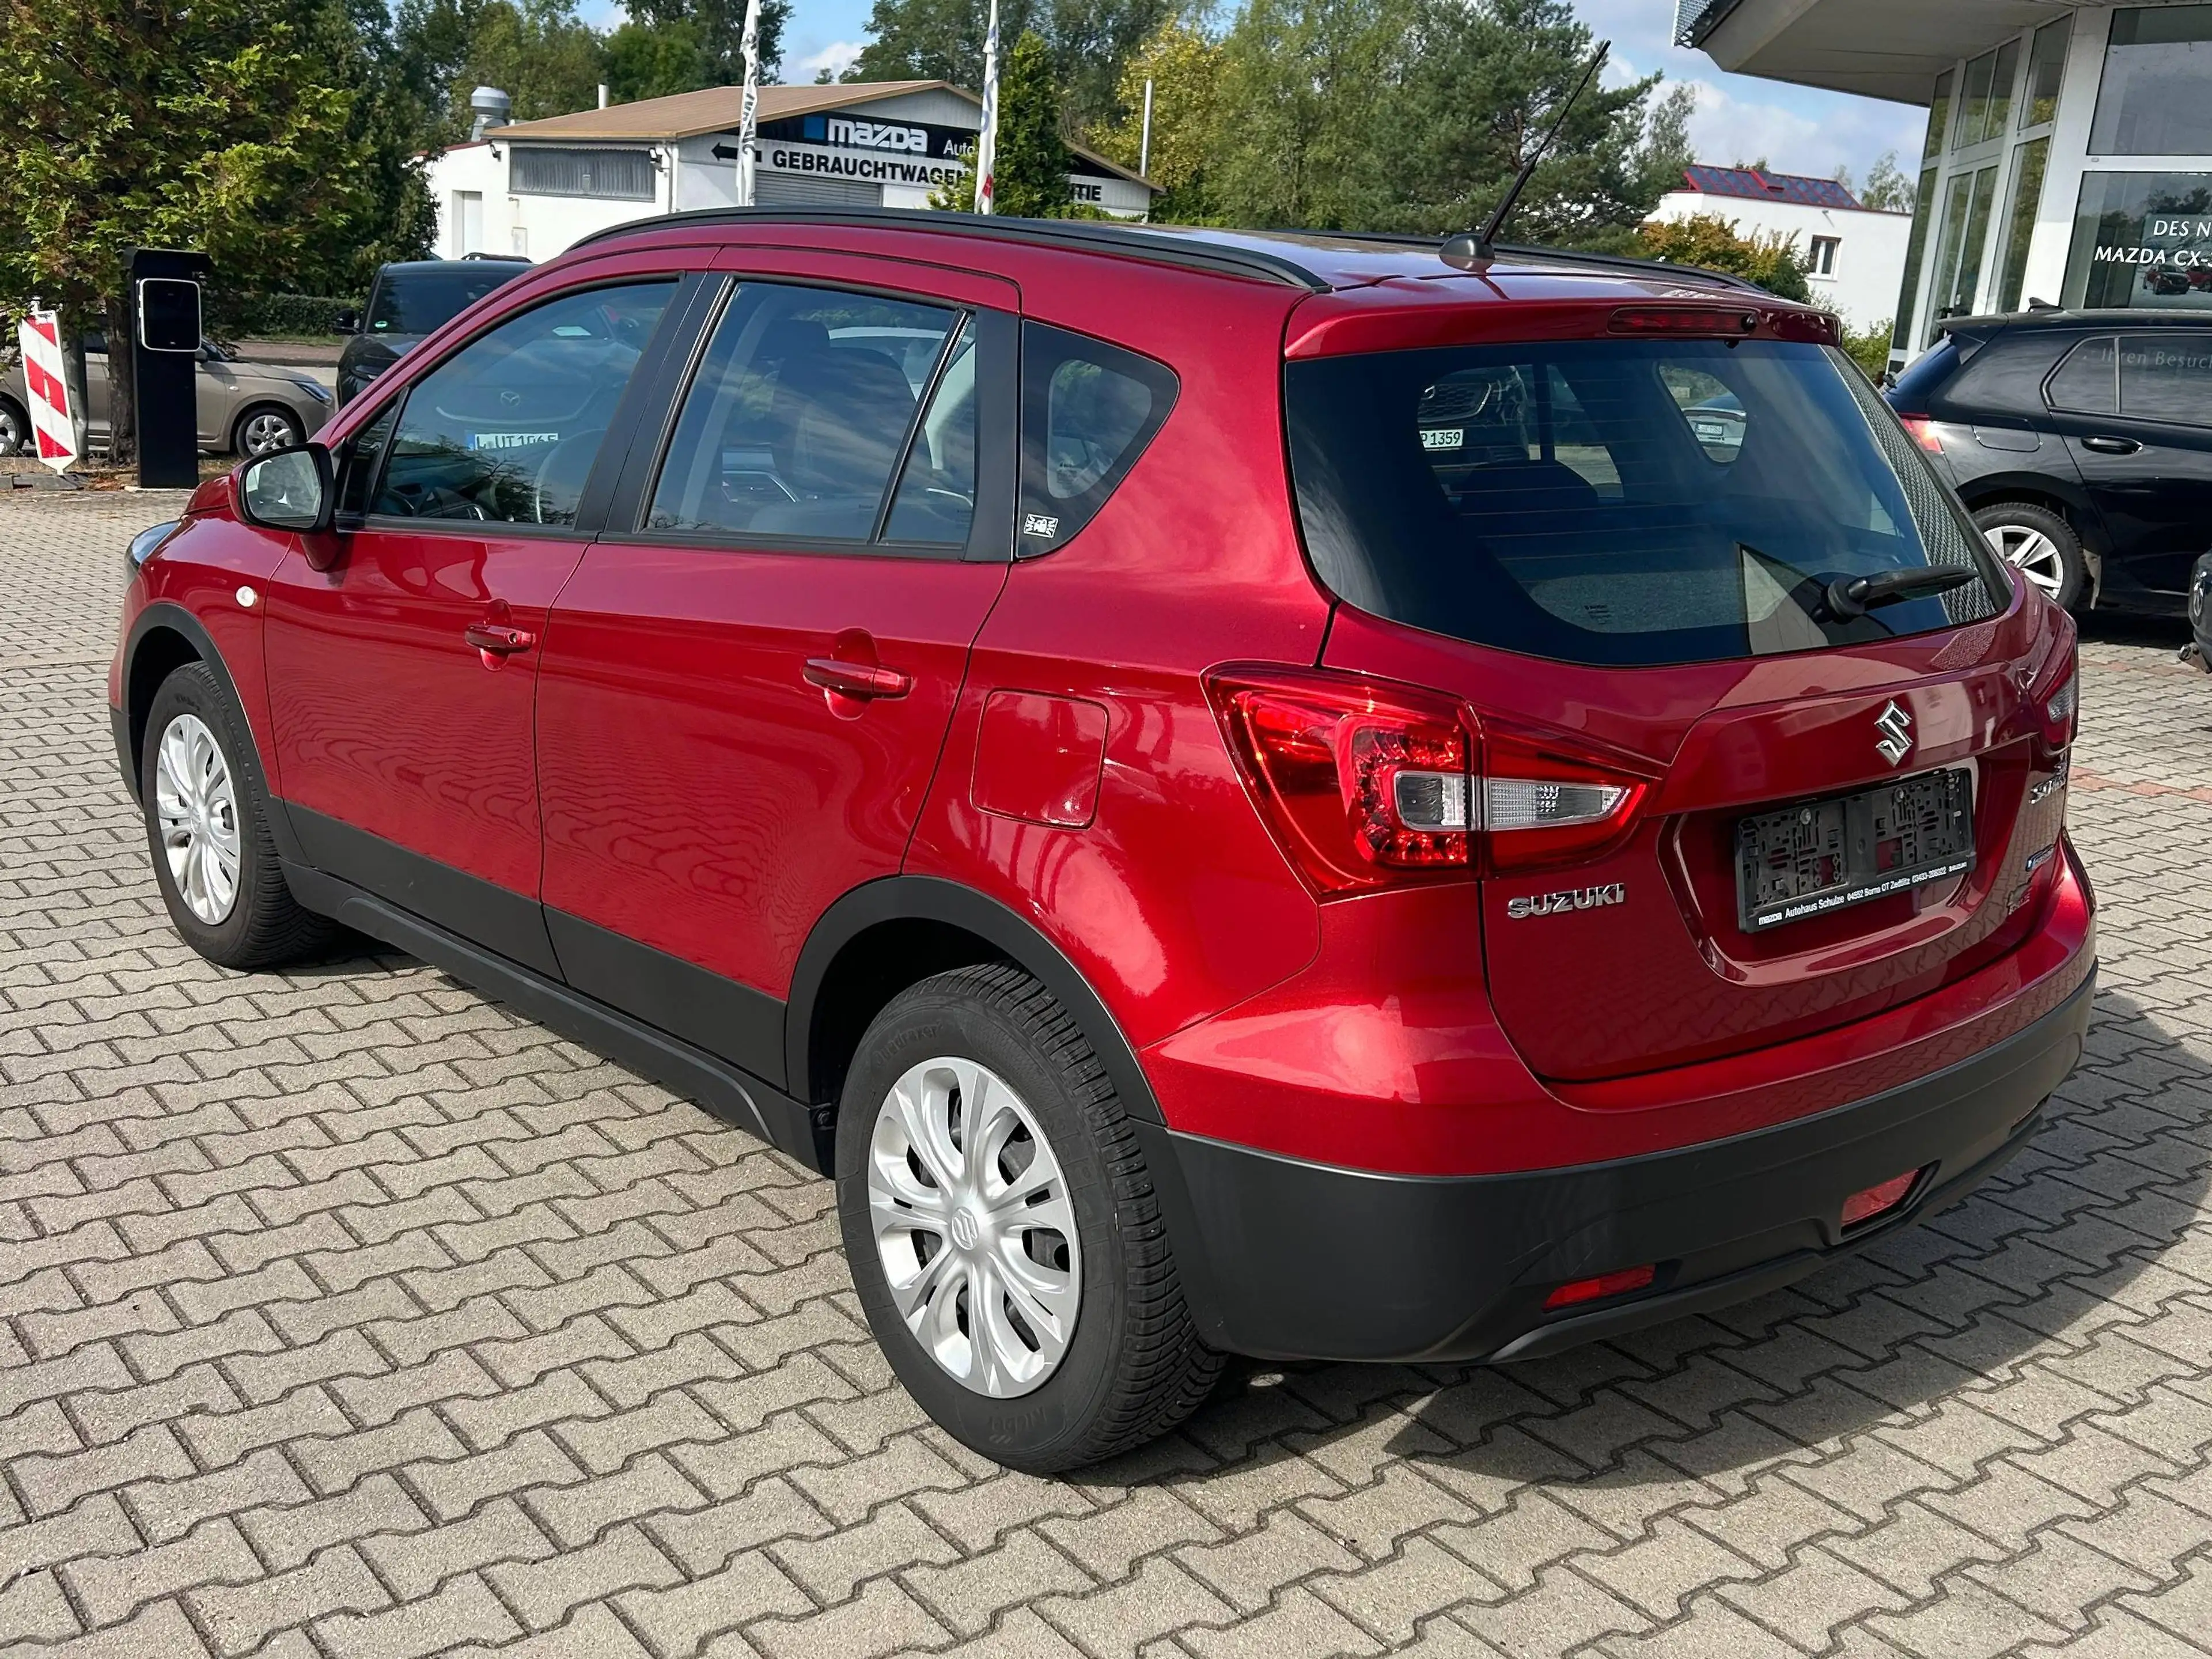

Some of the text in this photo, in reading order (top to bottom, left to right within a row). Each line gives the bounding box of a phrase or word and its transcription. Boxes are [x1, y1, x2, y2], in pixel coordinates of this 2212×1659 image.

[827, 118, 929, 153] mazda
[2153, 220, 2190, 237] DES
[2094, 245, 2166, 264] MAZDA
[1430, 431, 1461, 446] 1359
[1508, 882, 1625, 919] SUZUKI
[1785, 902, 1817, 918] Autohaus
[1818, 896, 1844, 910] Schulze
